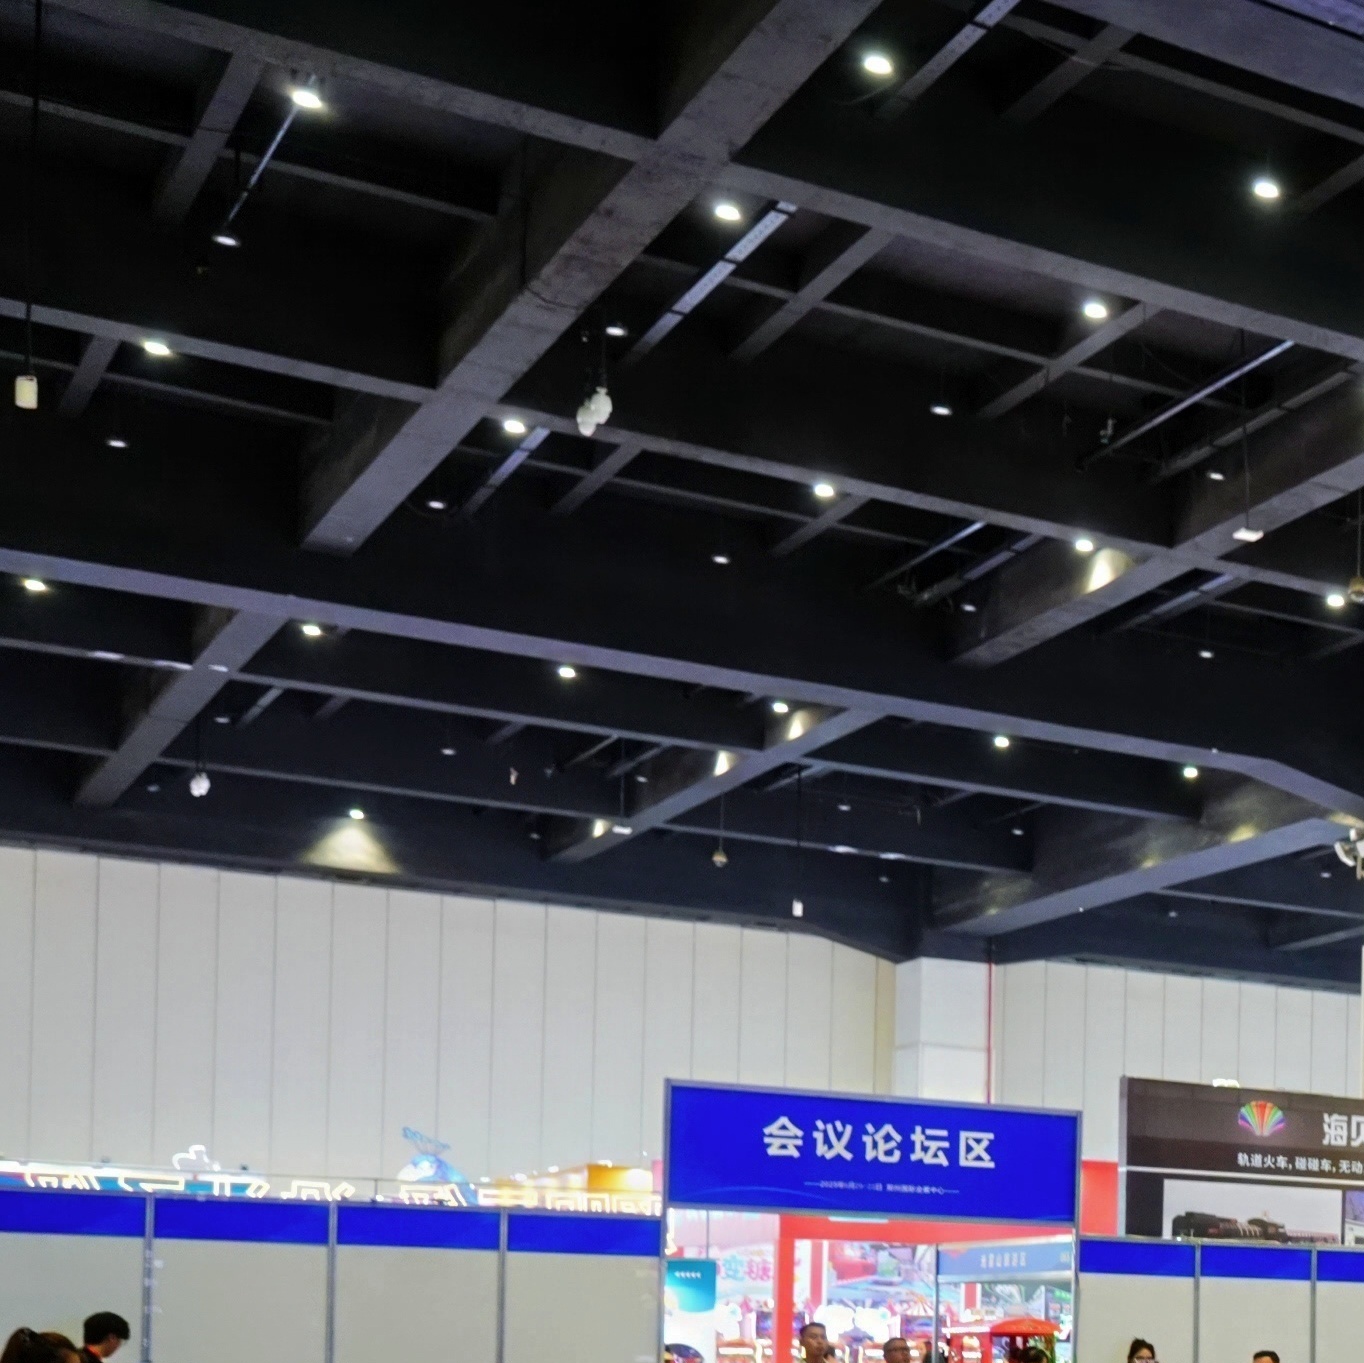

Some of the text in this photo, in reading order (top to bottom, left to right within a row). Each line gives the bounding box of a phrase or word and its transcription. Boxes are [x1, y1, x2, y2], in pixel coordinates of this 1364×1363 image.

[763, 1115, 997, 1169] 会议论坛区
